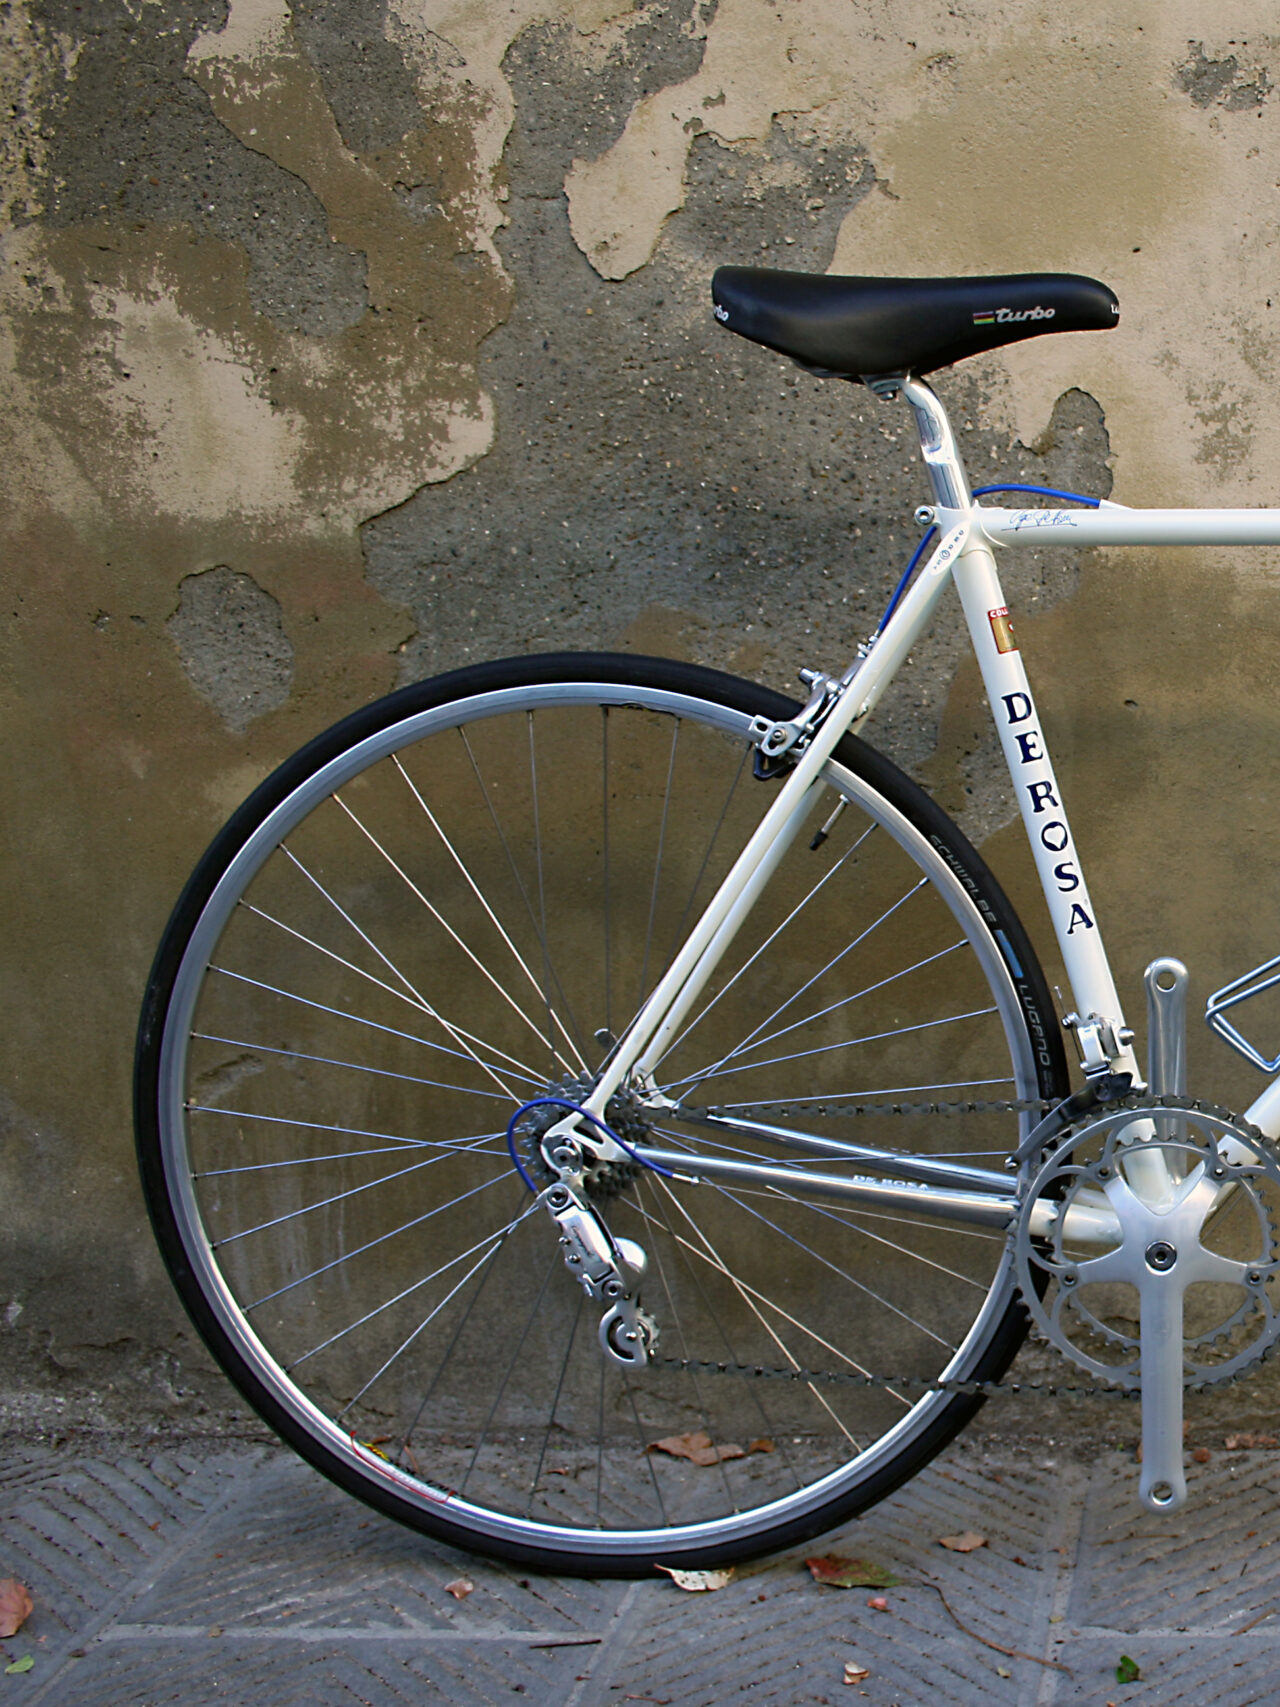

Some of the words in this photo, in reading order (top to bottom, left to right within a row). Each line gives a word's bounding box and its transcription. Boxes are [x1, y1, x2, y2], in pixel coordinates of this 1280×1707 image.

[995, 306, 1056, 323] turbo
[1001, 692, 1044, 764] DE
[1026, 780, 1094, 935] ROSA
[929, 834, 998, 924] SCHWALBE
[1018, 983, 1051, 1067] LUGANO
